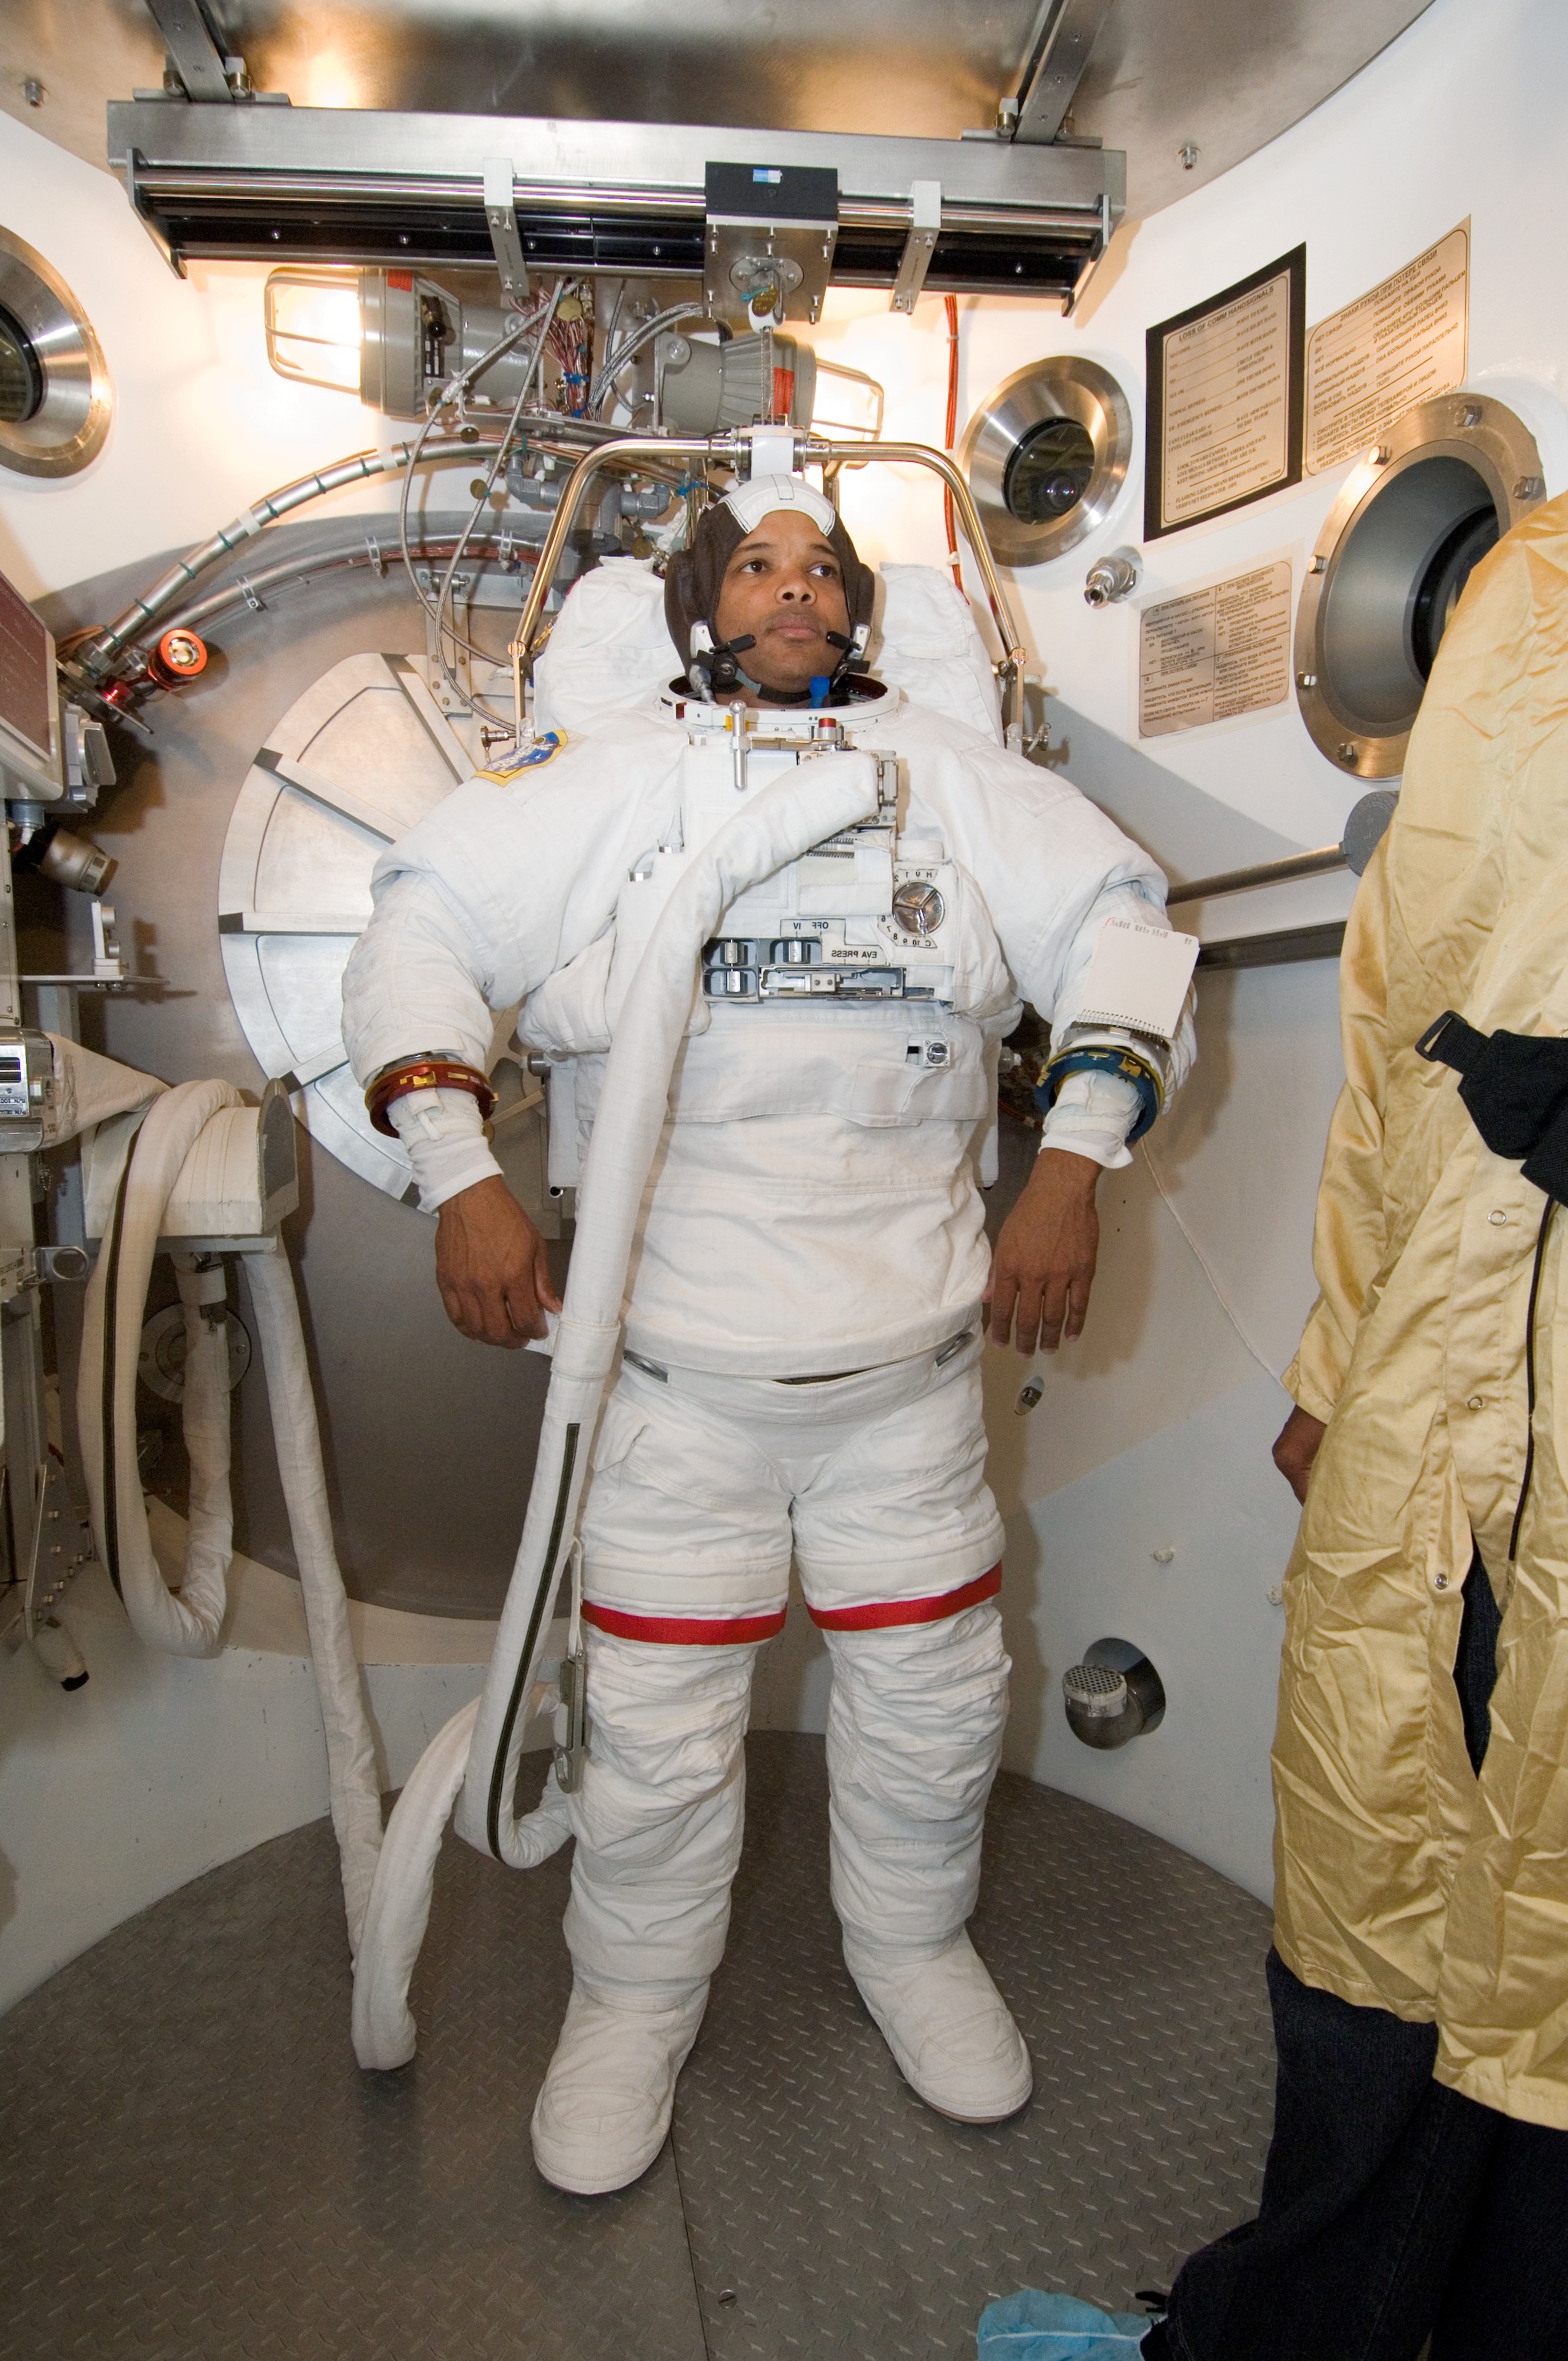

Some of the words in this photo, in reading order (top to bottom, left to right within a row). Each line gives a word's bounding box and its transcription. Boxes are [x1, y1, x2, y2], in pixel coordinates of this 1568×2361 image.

[1340, 304, 1359, 321] ЗНАКИ
[1360, 291, 1378, 309] РУКОЙ
[1380, 282, 1391, 294] ПРИ
[1394, 264, 1416, 286] ПОТЕРЕ
[1417, 249, 1437, 269] СВЯЗИ
[1419, 293, 1442, 314] ПАЛЬЦЕМ
[1179, 327, 1195, 341] LOSS
[1198, 323, 1204, 332] OF
[1208, 312, 1226, 327] COMM
[1228, 285, 1273, 316] HANDSIGNALS
[1237, 327, 1248, 337] WAVE
[1250, 320, 1263, 330] RIGHT
[1264, 312, 1277, 323] HAND
[1315, 334, 1324, 344] НЕТ
[1325, 323, 1341, 337] СВЯЗИ
[1374, 284, 1400, 306] ПОКАЖИТЕ
[1409, 271, 1420, 282] УШИ
[1315, 345, 1321, 354] ДА
[1374, 295, 1400, 317] ПОМАШИТЕ
[1404, 278, 1423, 297] ПРАВОЙ
[1424, 265, 1440, 282] РУКОЙ
[1315, 354, 1324, 364] НЕТ
[1374, 306, 1400, 328] ПОМАШИТЕ
[1404, 290, 1423, 308] ОБЕИМИ
[1426, 274, 1445, 292] РУКАМИ
[1325, 346, 1356, 368] НОРМАЛЬНО
[1374, 316, 1400, 339] ОБРАЗУЙТЕ
[1415, 289, 1440, 311] БОЛЬШИМ
[1441, 270, 1465, 291] ПАЛЬЦЕМ
[1176, 345, 1190, 355] COMM
[1257, 304, 1267, 314] EARS
[1237, 342, 1248, 352] WAVE
[1250, 335, 1261, 345] BOTH
[1263, 327, 1277, 338] HANDS
[1314, 365, 1348, 390] НОРМАЛЬНЫЙ
[1350, 353, 1369, 369] НАДДУВ
[1377, 340, 1390, 353] ОДИН
[1390, 321, 1415, 344] БОЛЬШОЙ
[1417, 310, 1433, 325] ПАЛЕЦ
[1434, 300, 1447, 314] ВНИЗ
[1237, 356, 1264, 374] FOREFINGER
[1314, 377, 1344, 400] АВАРИЙНЫЙ
[1346, 366, 1364, 381] НАДДУВ
[1376, 353, 1386, 364] ОБА
[1387, 337, 1411, 356] БОЛЬШИХ
[1413, 321, 1433, 340] ПАЛЬЦА
[1434, 311, 1447, 325] ВНИЗ
[1314, 394, 1346, 417] ОСТАНОВИТЬ
[1347, 383, 1367, 398] НАДДУВ
[1376, 359, 1403, 381] ПОМАШИТЕ
[1405, 347, 1420, 362] РУКОЙ
[1422, 322, 1457, 351] ПАРАЛЛЕЛЬНО
[1169, 406, 1185, 417] NORMAL
[1188, 397, 1205, 409] REPRESS
[1247, 370, 1261, 380] THUMB
[1262, 362, 1275, 372] DOWN
[1314, 399, 1327, 410] БОЛЬ
[1333, 390, 1341, 400] УХЕ
[1377, 375, 1390, 387] ПОЛУ
[1178, 412, 1203, 428] EMERGENCY
[1204, 403, 1222, 416] REPRESS
[1237, 391, 1247, 400] BOTH
[1249, 382, 1266, 394] THUMBS
[1267, 375, 1280, 385] DOWN
[1254, 410, 1267, 421] FLOOR
[1317, 427, 1338, 443] ДЕЛАЙТЕ
[1340, 416, 1357, 430] ЖЕСТЫ
[1359, 406, 1376, 420] МЕЖДУ
[1378, 383, 1412, 409] ТЕЛЕКАМЕРОЙ
[1317, 417, 1342, 436] СМОТРИТЕ
[1349, 396, 1380, 418] ТЕЛЕКАМЕРУ
[1350, 420, 1364, 431] ЕСЛИ
[1375, 394, 1406, 417] НОРМАЛЬНО
[1168, 443, 1181, 453] LEVEL
[1191, 430, 1211, 443] CHAMBER
[1236, 413, 1248, 422] WAVE
[1260, 396, 1281, 410] PARALLEL
[1180, 430, 1194, 440] CLEAR
[1317, 444, 1344, 463] МИГАЮЩЕЕ
[1346, 427, 1377, 448] ОСВЕЩЕНИЕ
[1383, 410, 1404, 427] ЗНАЧАЕТ
[1350, 443, 1360, 453] ЧТО
[1362, 435, 1374, 447] ВОДА
[1177, 470, 1187, 478] GIVE
[1188, 462, 1205, 473] SIGNALS
[1206, 453, 1226, 465] BETWEEN
[1227, 445, 1244, 456] CAMERA
[1177, 462, 1188, 471] LOOK
[1190, 454, 1208, 465] TOWARD
[1177, 477, 1188, 485] KEEP
[1188, 469, 1205, 480] MOVING
[1207, 461, 1224, 473] AROUND
[1176, 490, 1196, 503] FLASHING
[1197, 484, 1212, 494] LIGHTS
[1213, 478, 1227, 488] MEANS
[1228, 470, 1245, 482] REPRESS
[1201, 486, 1225, 500] FEEDWATER
